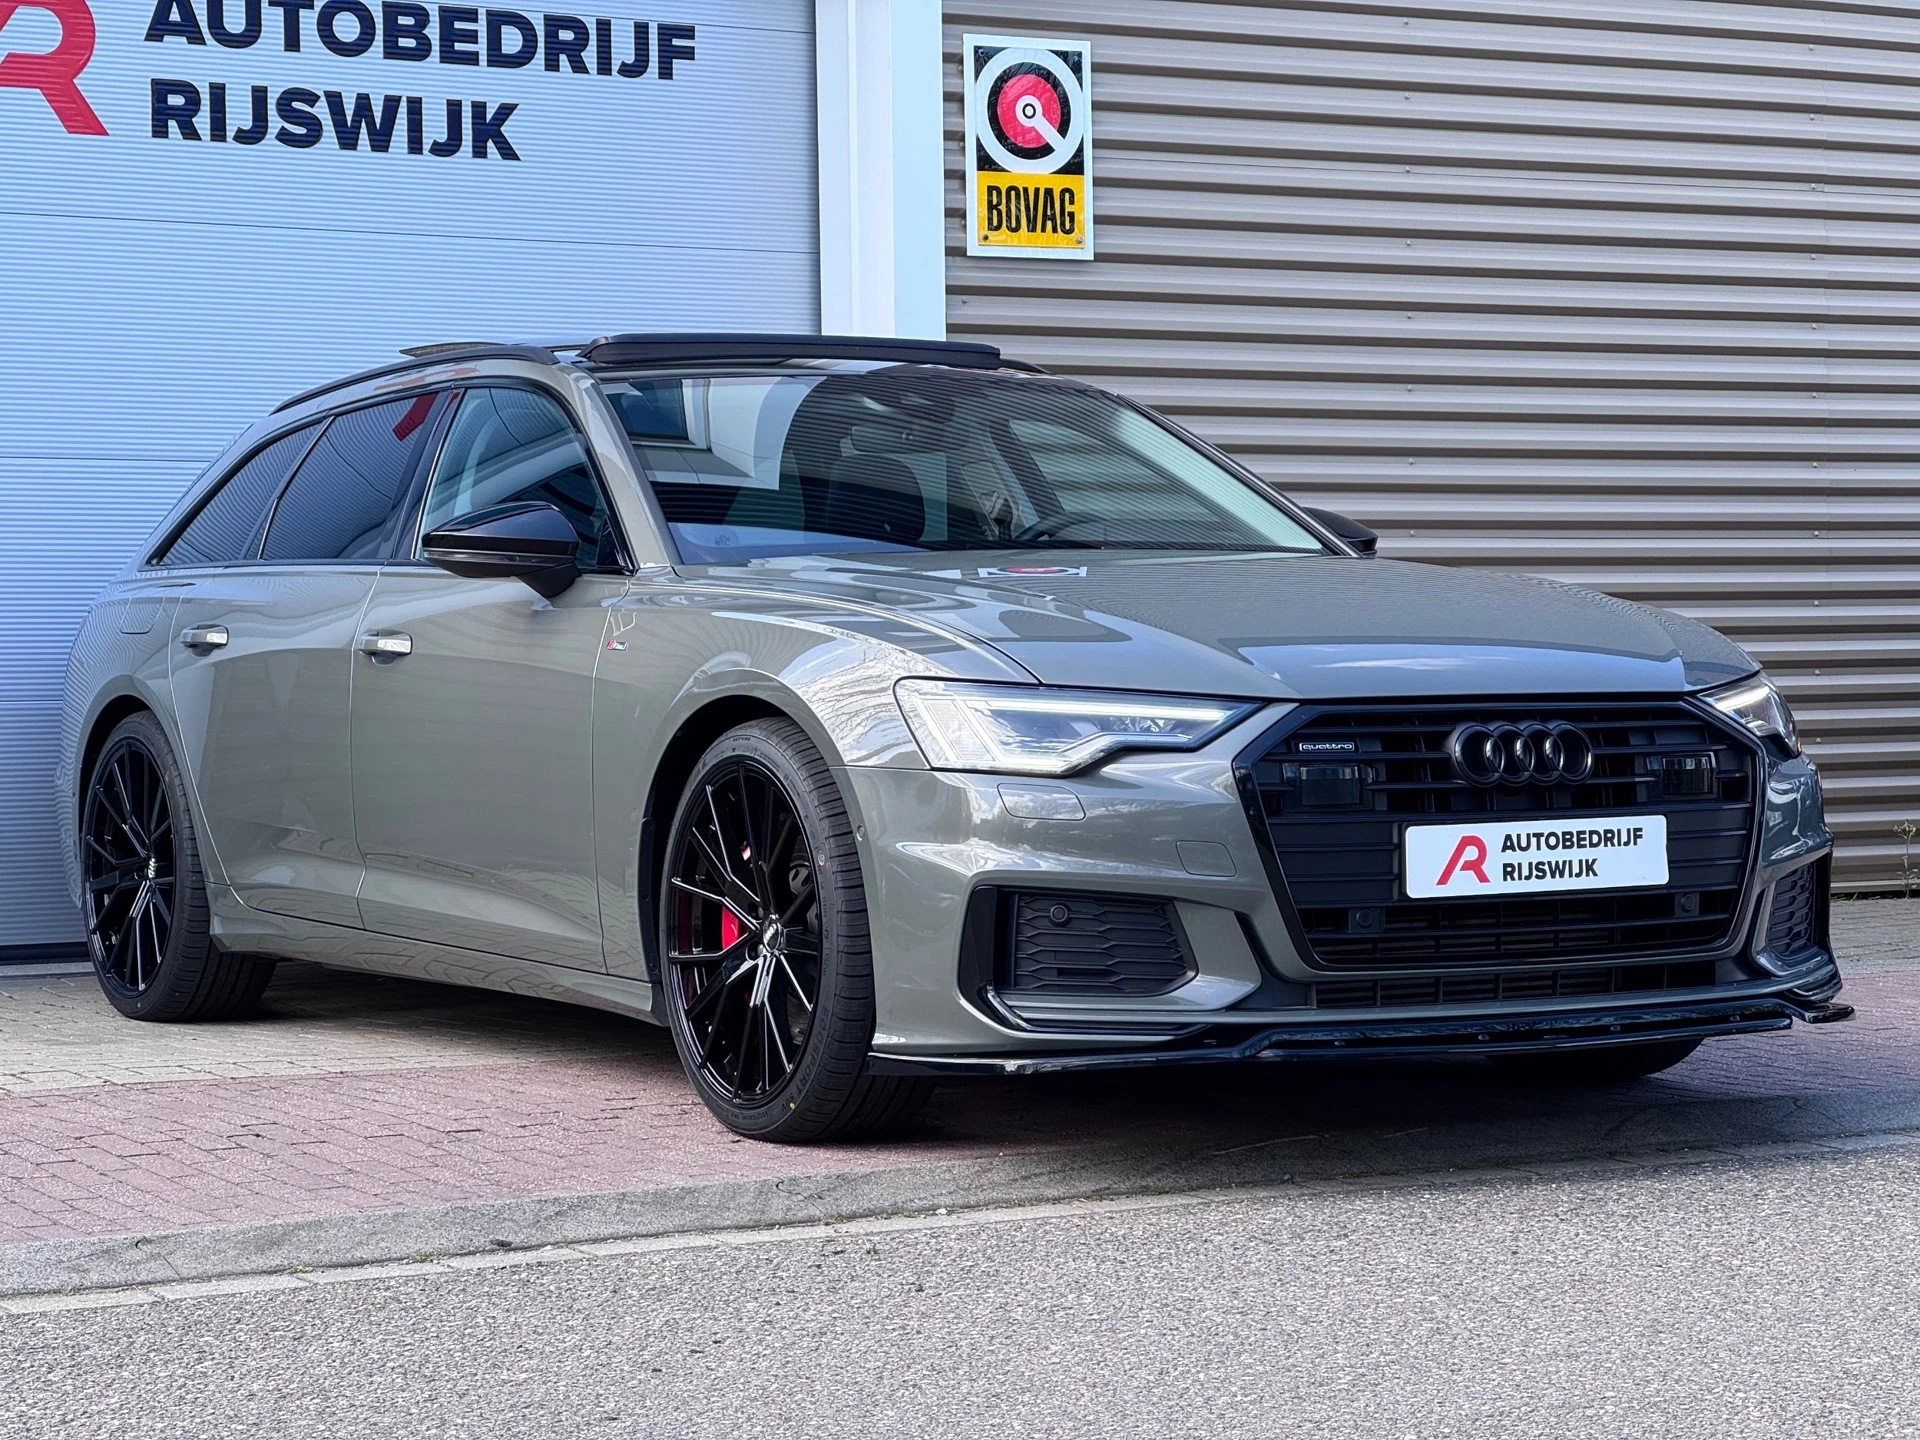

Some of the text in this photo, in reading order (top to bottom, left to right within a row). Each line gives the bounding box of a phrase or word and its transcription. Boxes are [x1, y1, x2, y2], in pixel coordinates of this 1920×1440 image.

[144, 0, 696, 80] AUTOBEDRIJF
[150, 78, 522, 161] RIJSWIJK
[986, 184, 1075, 235] BOVAG
[1302, 743, 1353, 751] quattro
[1501, 828, 1643, 853] AUTOBEDRIJF
[1502, 858, 1599, 882] RIJSWIJK
